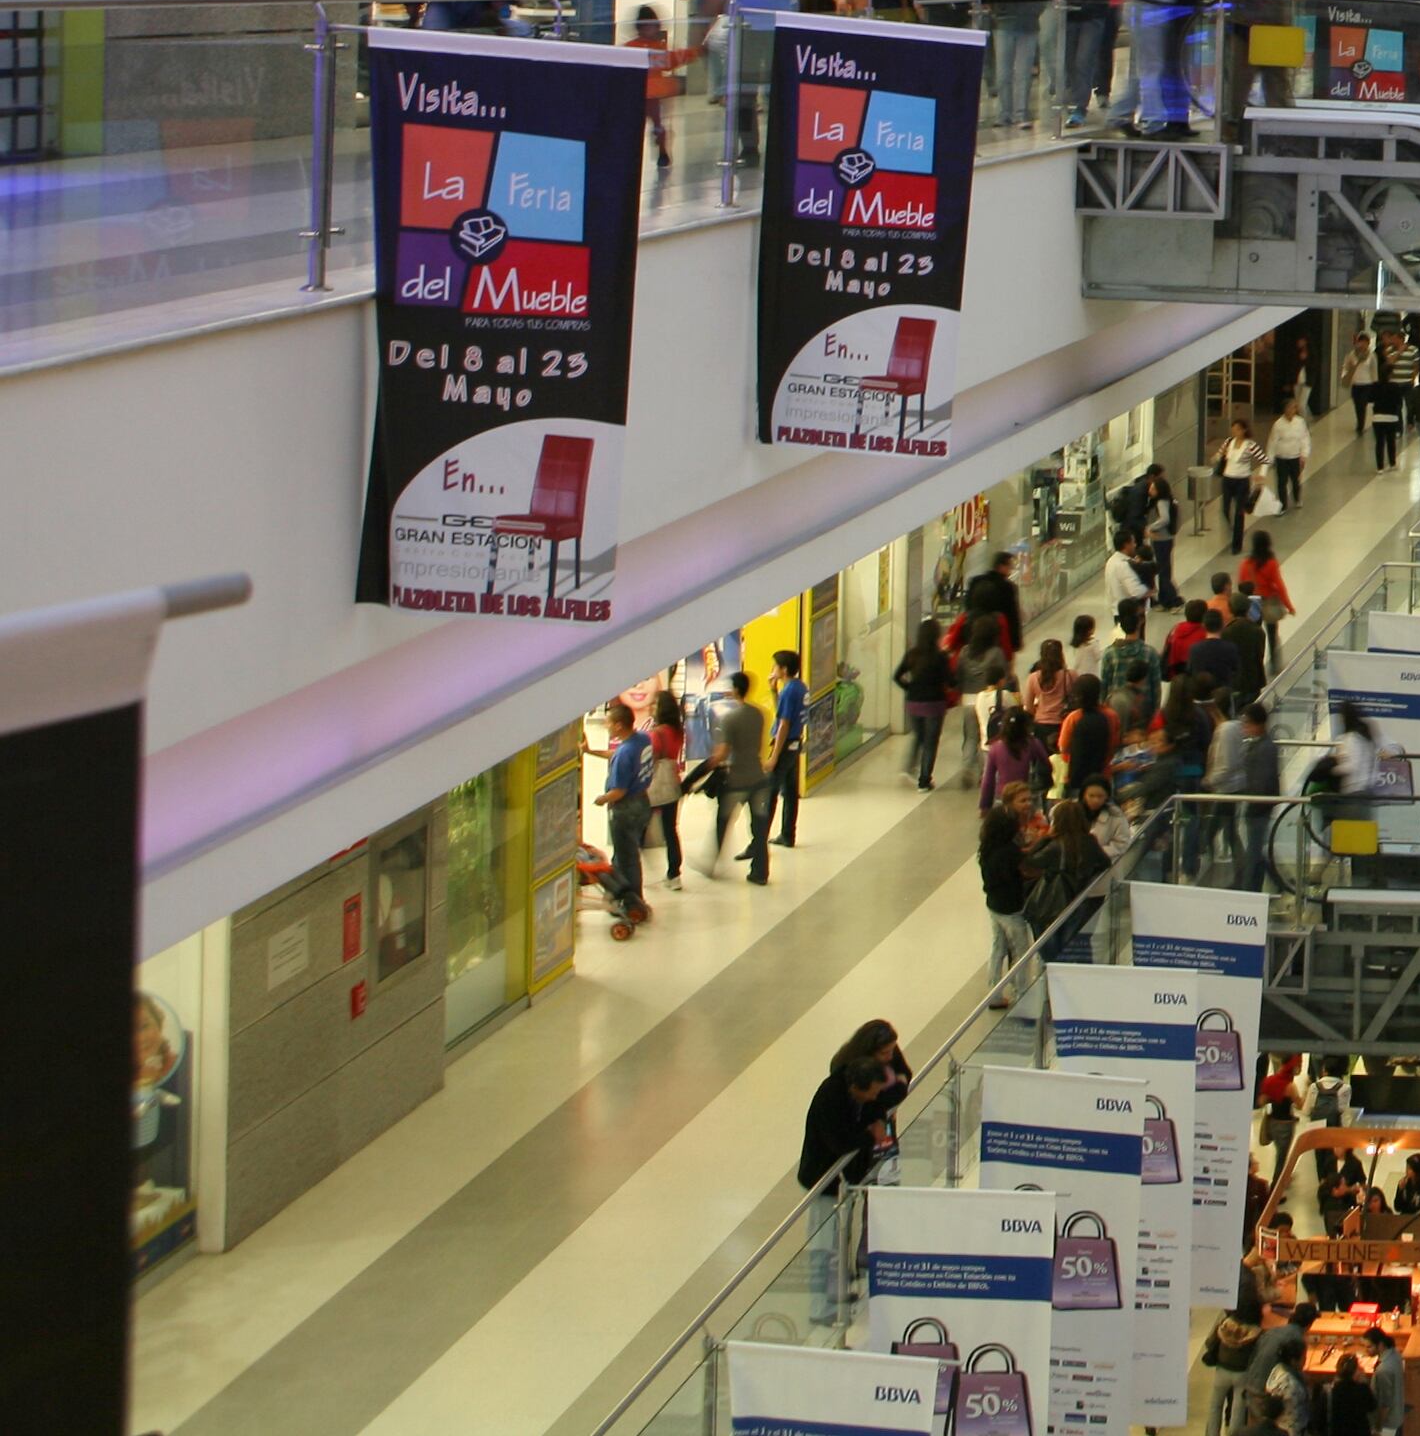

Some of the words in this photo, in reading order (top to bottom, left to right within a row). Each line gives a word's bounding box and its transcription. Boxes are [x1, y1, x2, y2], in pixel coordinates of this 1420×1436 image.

[1338, 41, 1355, 57] La
[1331, 82, 1350, 97] del
[1358, 82, 1405, 100] Mueble
[813, 112, 844, 141] La
[878, 121, 924, 151] Feria
[423, 162, 464, 200] La
[509, 172, 571, 212] Feria
[797, 188, 833, 216] del
[849, 190, 934, 227] Mueble
[787, 244, 830, 267] Del
[841, 249, 855, 269] 8
[864, 252, 887, 272] al
[898, 254, 934, 275] 23
[401, 265, 450, 300] del
[473, 266, 587, 313] Mueble
[825, 270, 891, 299] Mayo
[389, 340, 449, 369] Del
[464, 345, 483, 371] 8
[496, 347, 527, 375] al
[542, 350, 588, 379] 23
[824, 333, 869, 361] En...
[443, 374, 532, 411] Mayo
[788, 383, 826, 395] GRAN
[777, 426, 846, 448] PLAZOLETA
[848, 432, 866, 449] DE
[869, 434, 893, 452] LOS
[896, 438, 947, 456] ALFILES
[443, 459, 504, 494] En...
[395, 528, 444, 544] GRAN
[451, 530, 542, 550] ESTACION
[1059, 522, 1076, 531] Wii
[480, 591, 504, 614] DE
[508, 594, 540, 617] LOS
[544, 597, 611, 621] ALFILES
[1227, 914, 1258, 927] BBVA
[1154, 993, 1187, 1005] BBVA
[1096, 1098, 1133, 1113] BBVA
[1001, 1219, 1042, 1233] BBVA
[1285, 1243, 1378, 1261] WETLINE
[874, 1386, 921, 1404] BBVA
